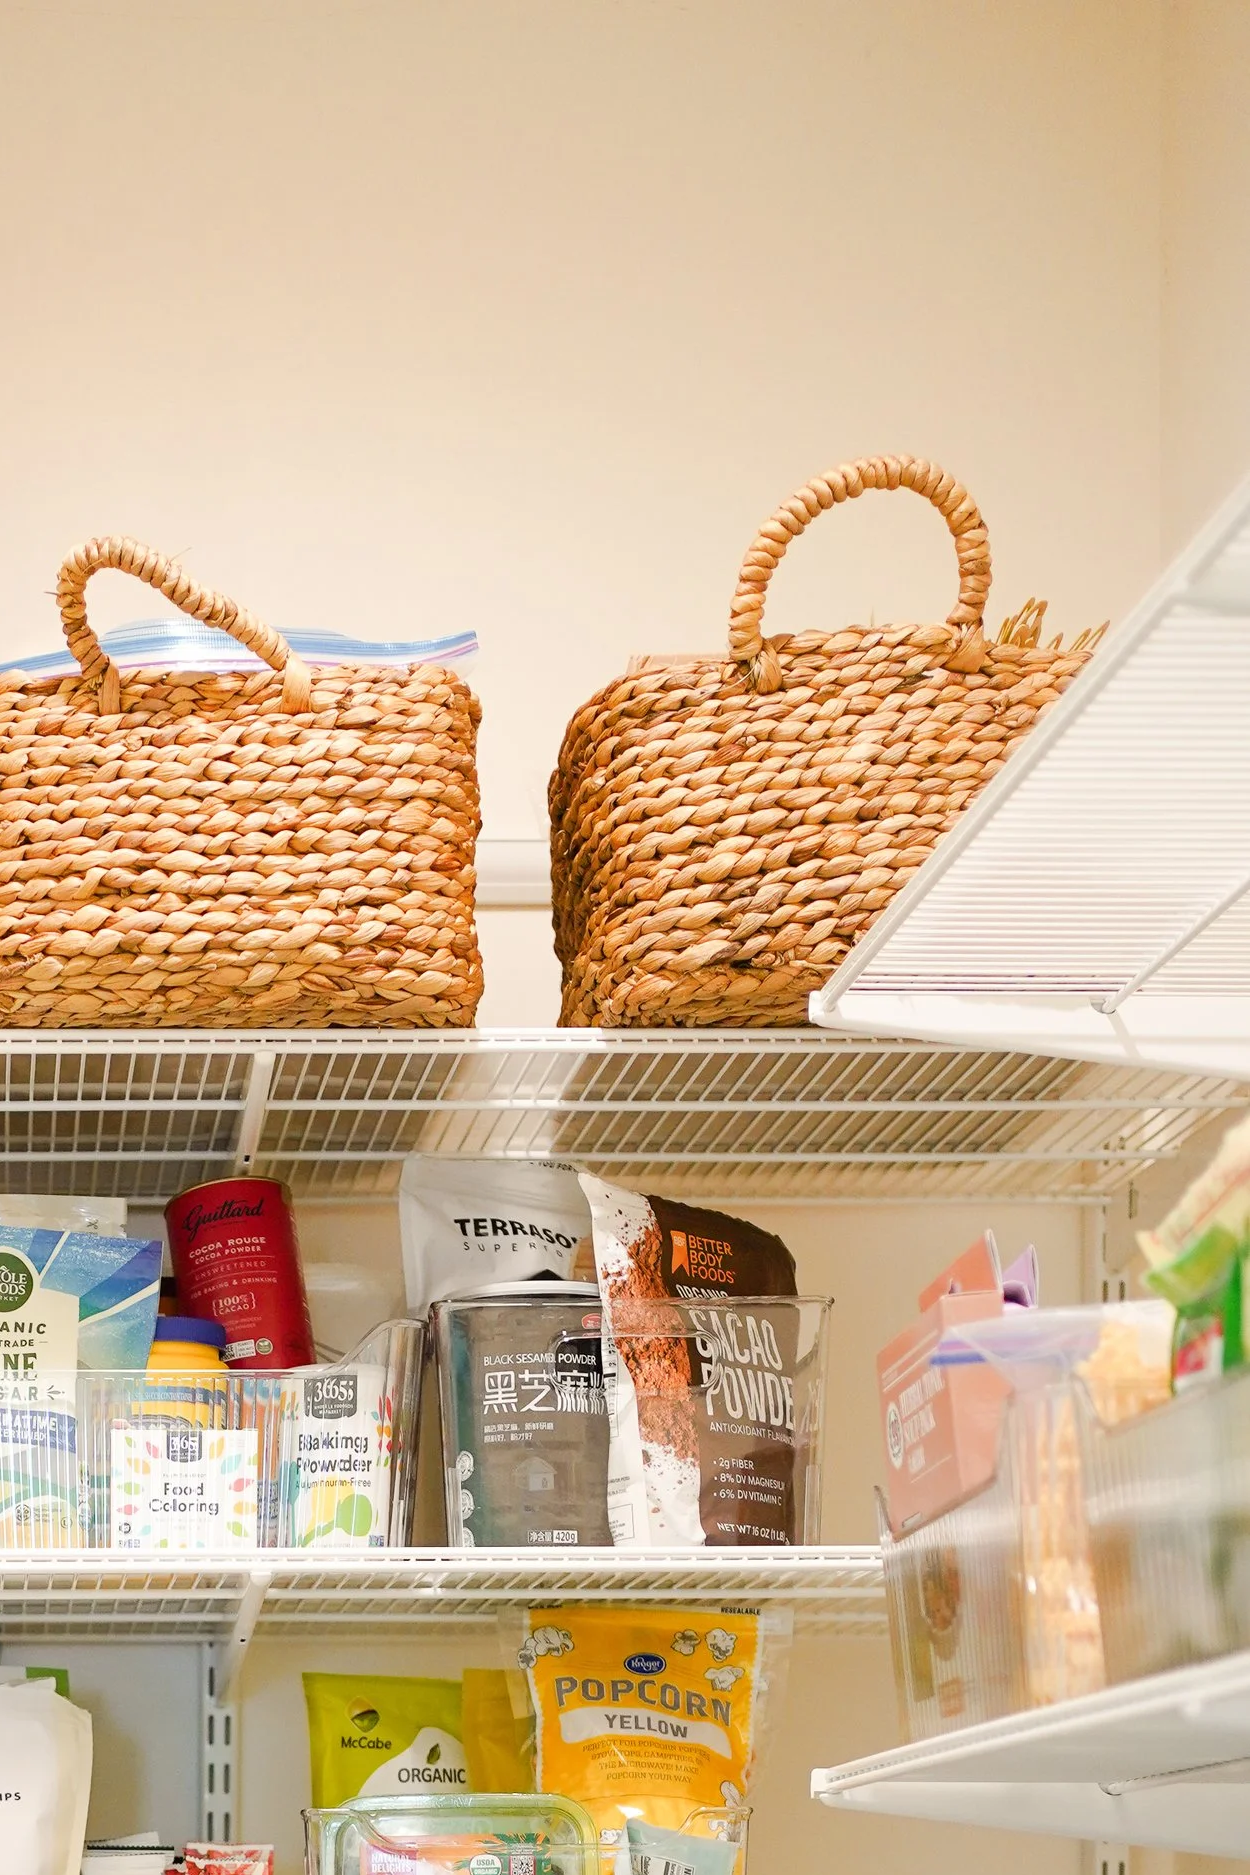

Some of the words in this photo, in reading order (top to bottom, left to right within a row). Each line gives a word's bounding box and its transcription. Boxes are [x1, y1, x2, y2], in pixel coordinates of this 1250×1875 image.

[183, 1200, 265, 1242] Guittard
[189, 1242, 222, 1259] COCOA
[228, 1237, 266, 1245] ROUGE
[688, 1235, 733, 1256] BETTER
[195, 1252, 221, 1265] COCOA
[225, 1246, 261, 1255] POWDER
[690, 1251, 723, 1268] BODY
[219, 1305, 250, 1315] CACAO
[484, 1354, 514, 1366] BLACK
[557, 1354, 596, 1365] POWDER
[164, 1482, 204, 1496] Food
[149, 1499, 219, 1515] Coloring
[554, 1532, 577, 1543] 420g
[554, 1676, 731, 1727] POPCORN
[604, 1713, 688, 1738] YELLOW
[341, 1736, 392, 1750] McCabe
